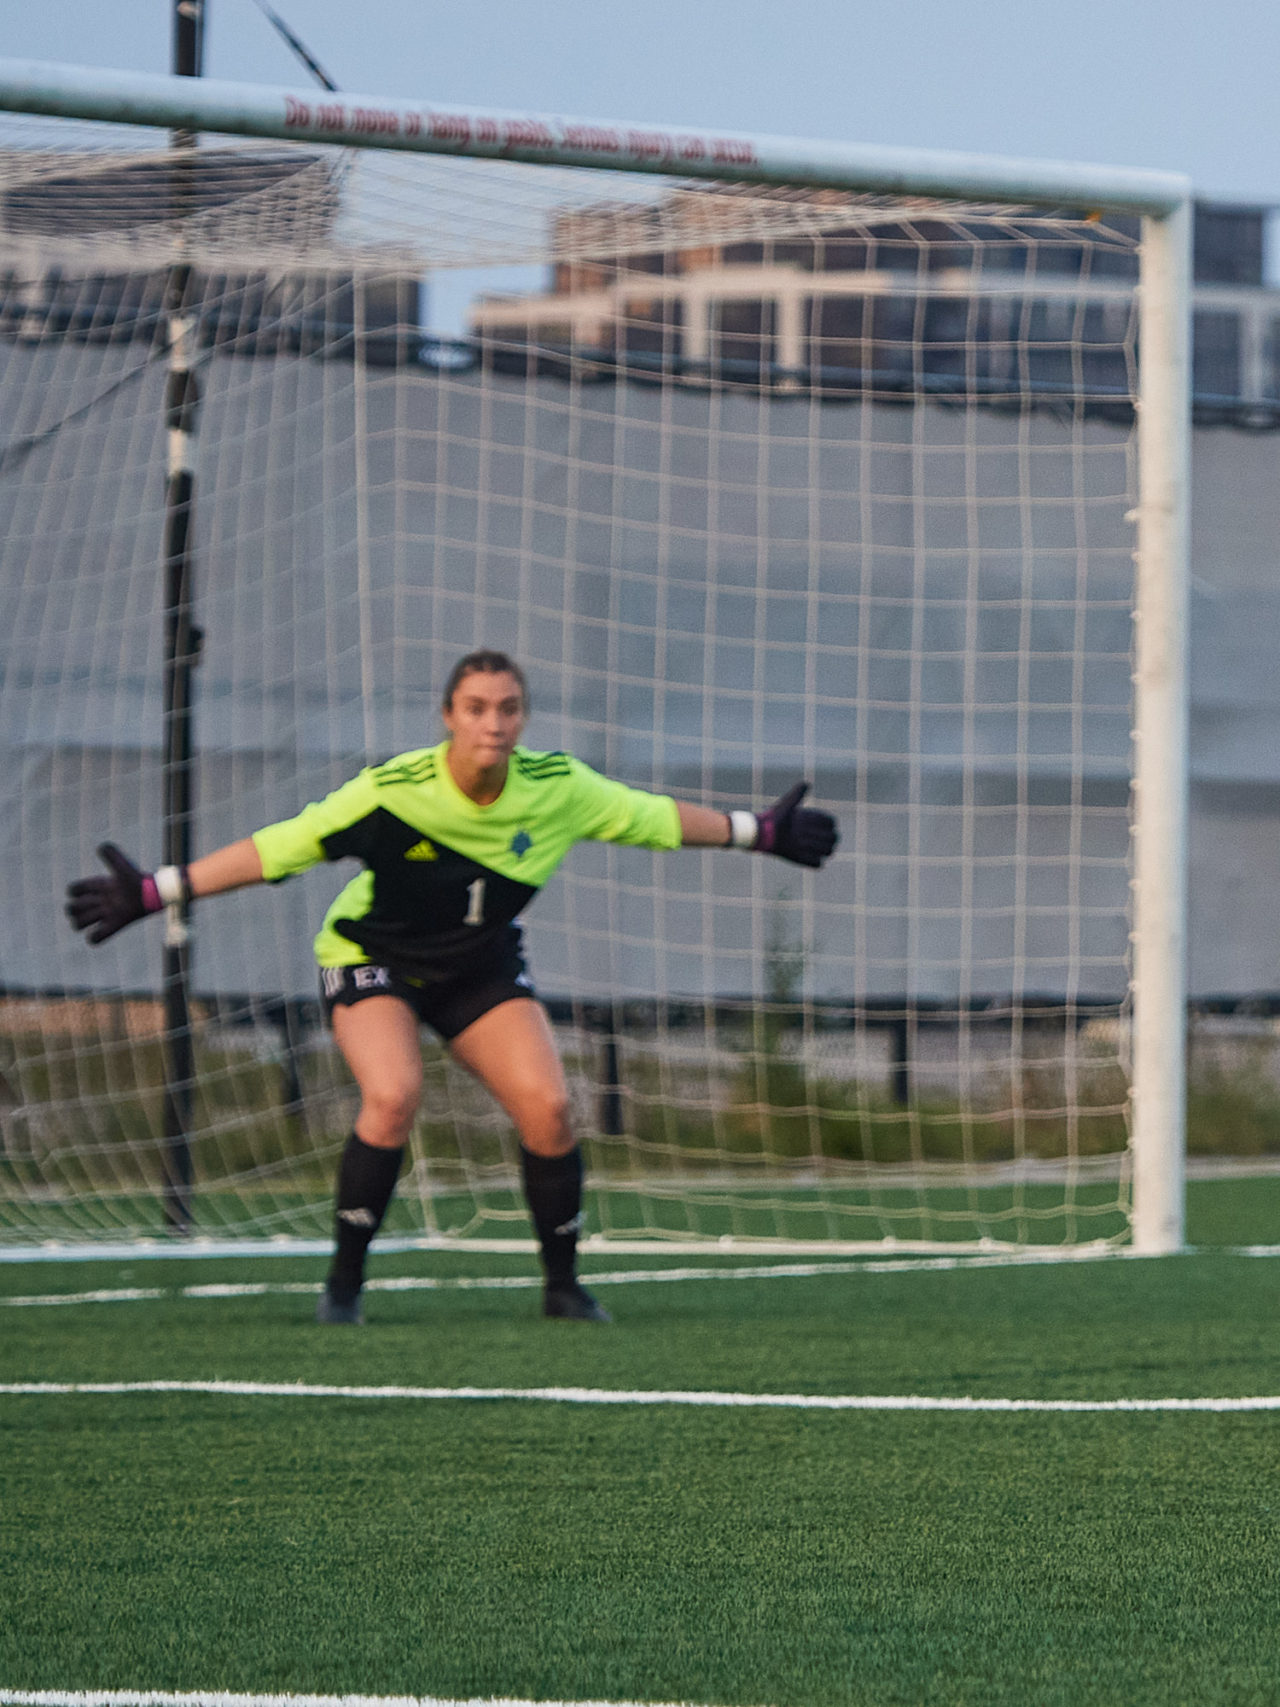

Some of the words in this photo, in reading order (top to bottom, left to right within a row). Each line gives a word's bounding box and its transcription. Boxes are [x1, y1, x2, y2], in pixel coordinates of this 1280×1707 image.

[284, 95, 311, 128] Do
[316, 103, 345, 131] not
[351, 107, 400, 134] move
[404, 110, 422, 137] or
[476, 117, 498, 143] on
[674, 133, 705, 160] can
[462, 877, 486, 926] 1
